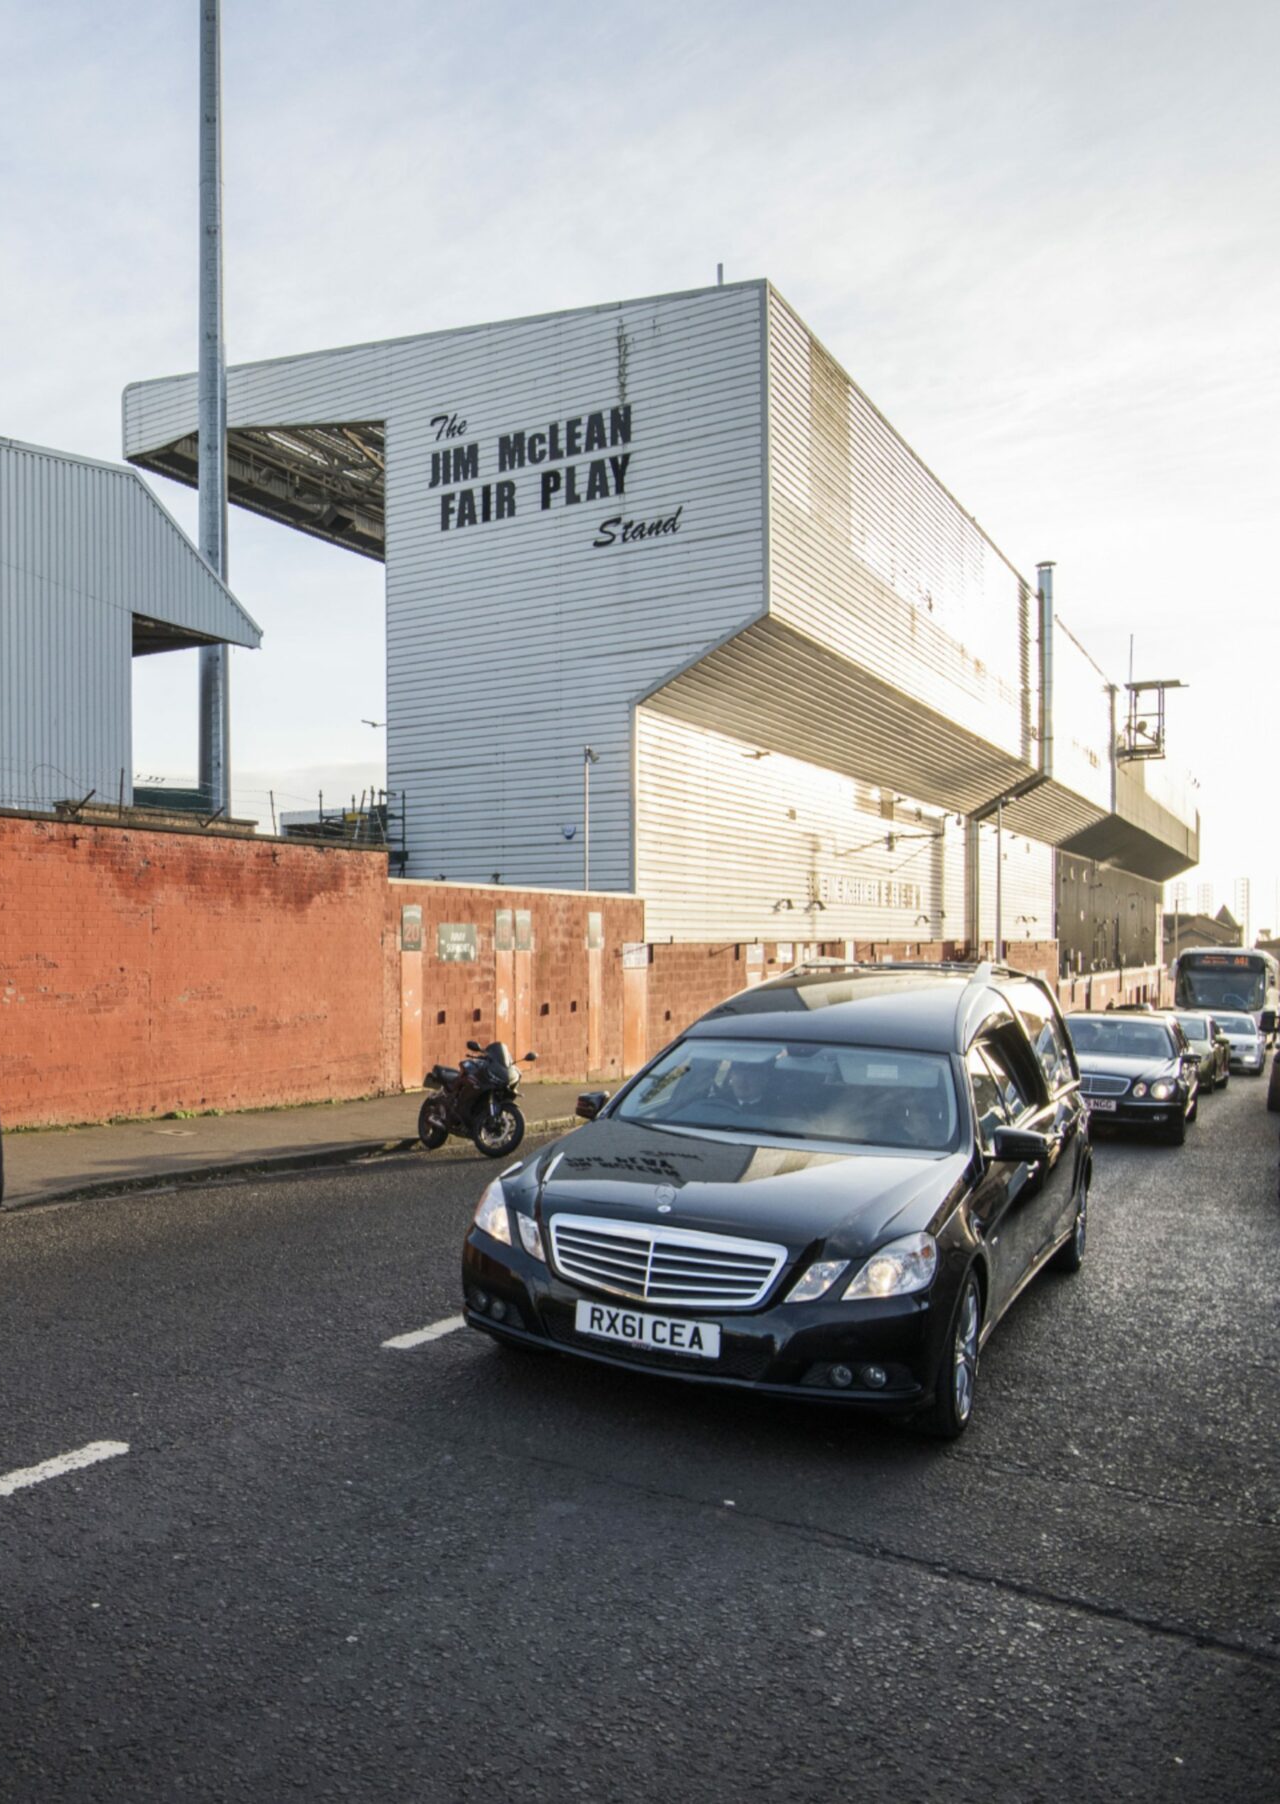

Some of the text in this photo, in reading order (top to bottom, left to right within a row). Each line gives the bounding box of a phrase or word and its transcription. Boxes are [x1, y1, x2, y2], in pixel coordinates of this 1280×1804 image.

[429, 404, 632, 489] JIM McLEAN
[430, 413, 467, 441] The
[441, 453, 632, 532] FAIR PLAY
[593, 505, 684, 548] Stand
[590, 1306, 704, 1351] RX61 CEA
